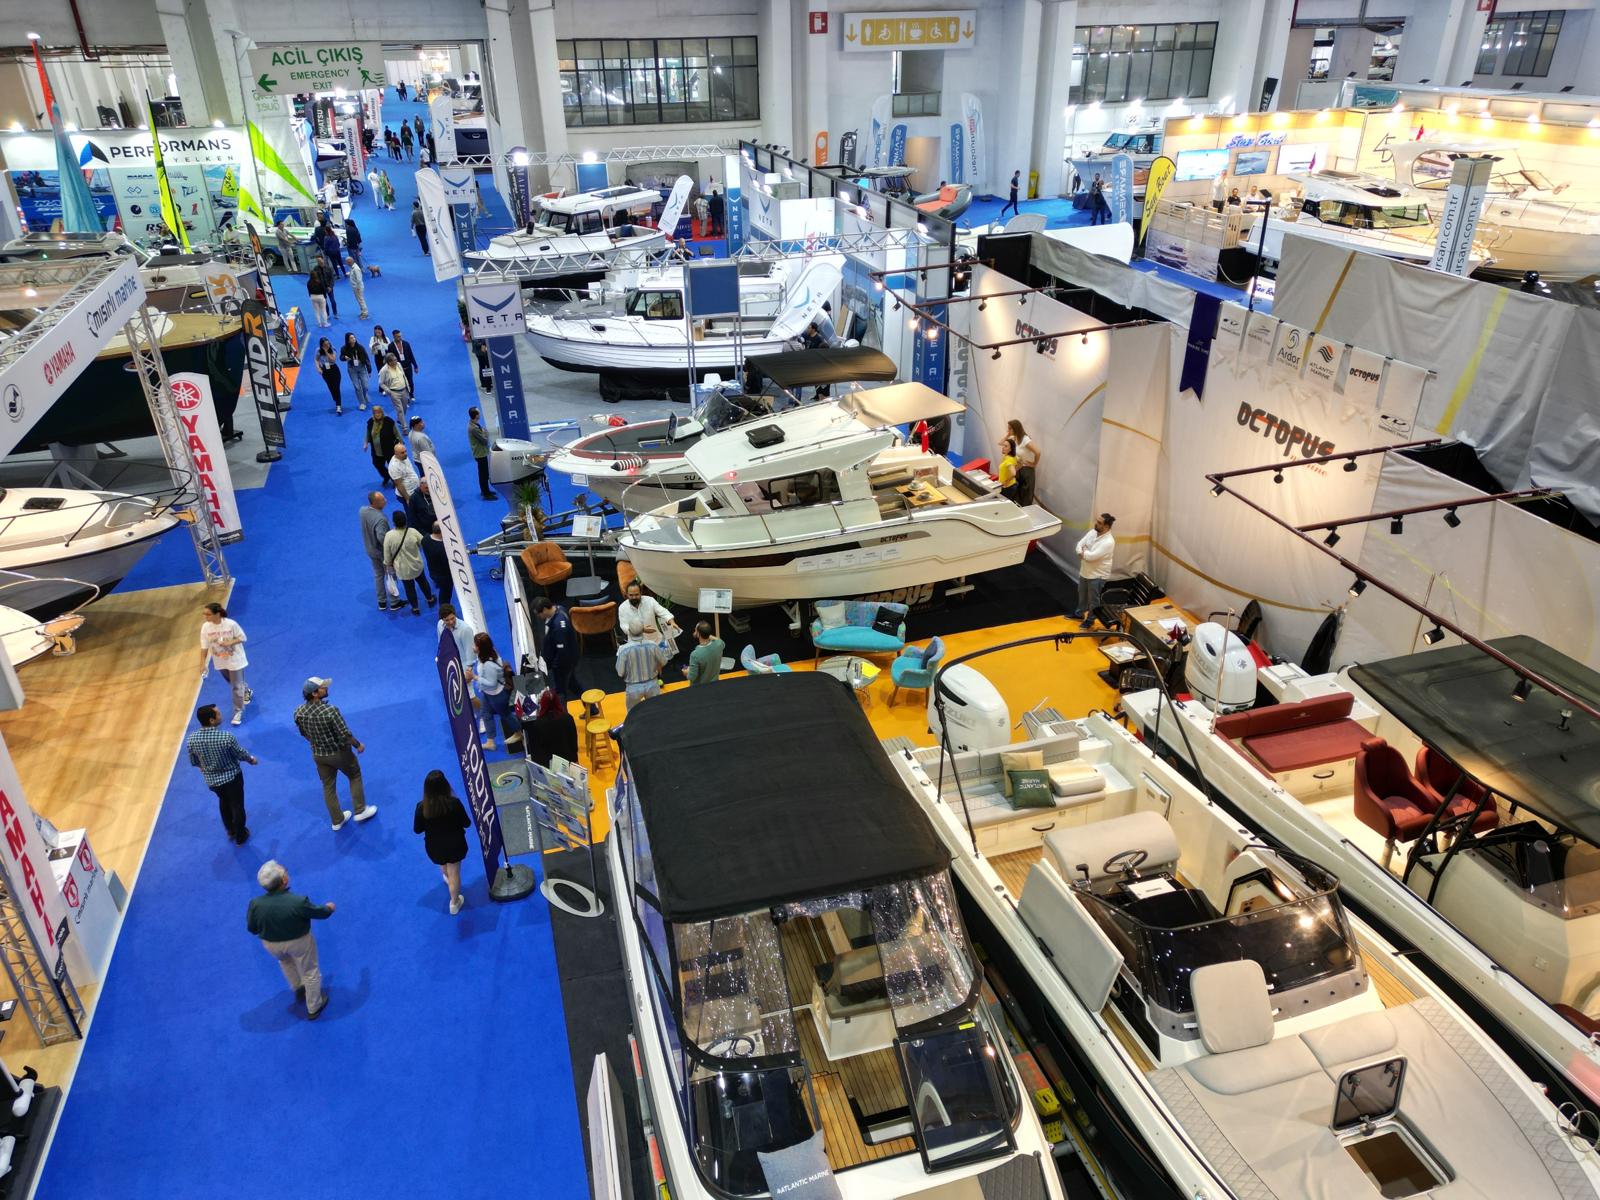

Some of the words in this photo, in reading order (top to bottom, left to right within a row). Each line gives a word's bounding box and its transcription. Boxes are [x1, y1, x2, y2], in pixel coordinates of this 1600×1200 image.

[272, 47, 313, 66] ACİL
[316, 47, 364, 67] ÇIKIŞ
[290, 69, 350, 81] EMERGENCY
[312, 81, 333, 90] EXIT
[110, 138, 232, 158] PERFORMANS
[173, 155, 234, 163] YELKEN
[1435, 193, 1459, 271] rsan.com.tr
[115, 275, 138, 308] marine
[472, 313, 523, 326] NETA
[50, 340, 76, 379] YAMAHA
[243, 310, 278, 420] TENDR
[1278, 347, 1301, 364] Ardor
[1309, 362, 1334, 376] ATLANTIC
[1310, 368, 1330, 381] MARINE
[1349, 367, 1380, 383] OCTOPUS
[501, 364, 518, 420] NETA
[1237, 400, 1336, 466] OCTOPUS
[181, 414, 225, 529] YAMAHA
[880, 533, 908, 544] OCTOPUS
[0, 790, 54, 947] AMAHA
[780, 1178, 808, 1194] ATLANTIC
[808, 1168, 829, 1183] MARINE
